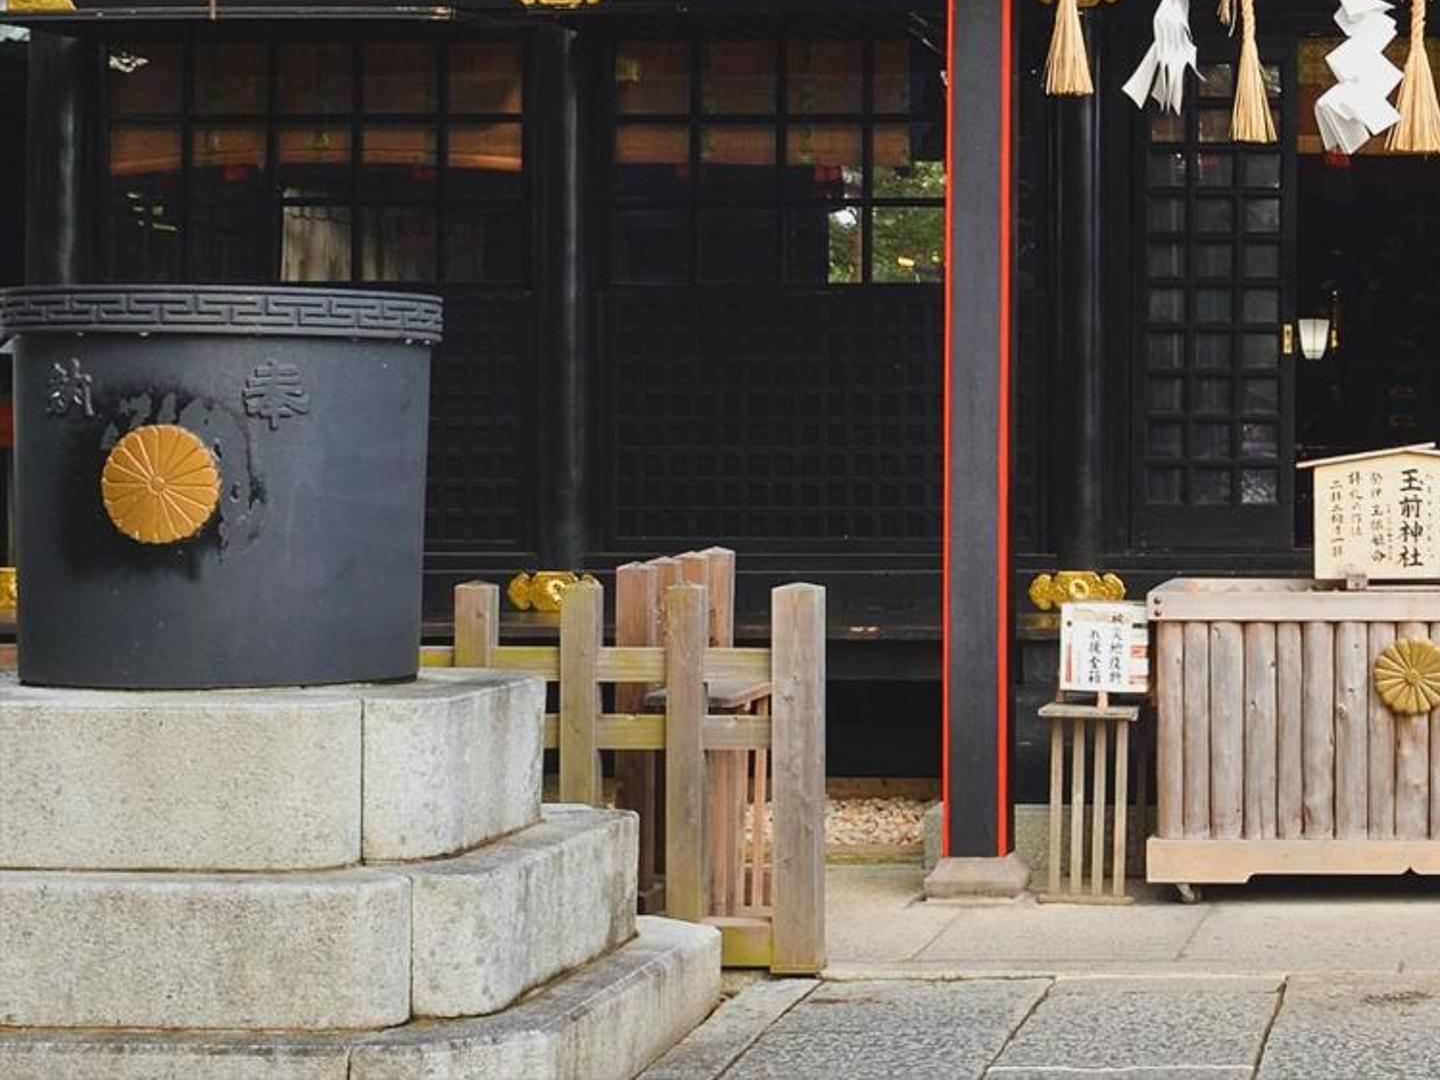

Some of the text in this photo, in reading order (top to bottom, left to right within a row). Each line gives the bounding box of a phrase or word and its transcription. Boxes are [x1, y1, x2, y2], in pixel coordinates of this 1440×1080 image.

[46, 356, 311, 430] 奉 納
[1398, 468, 1423, 568] 玉前神社
